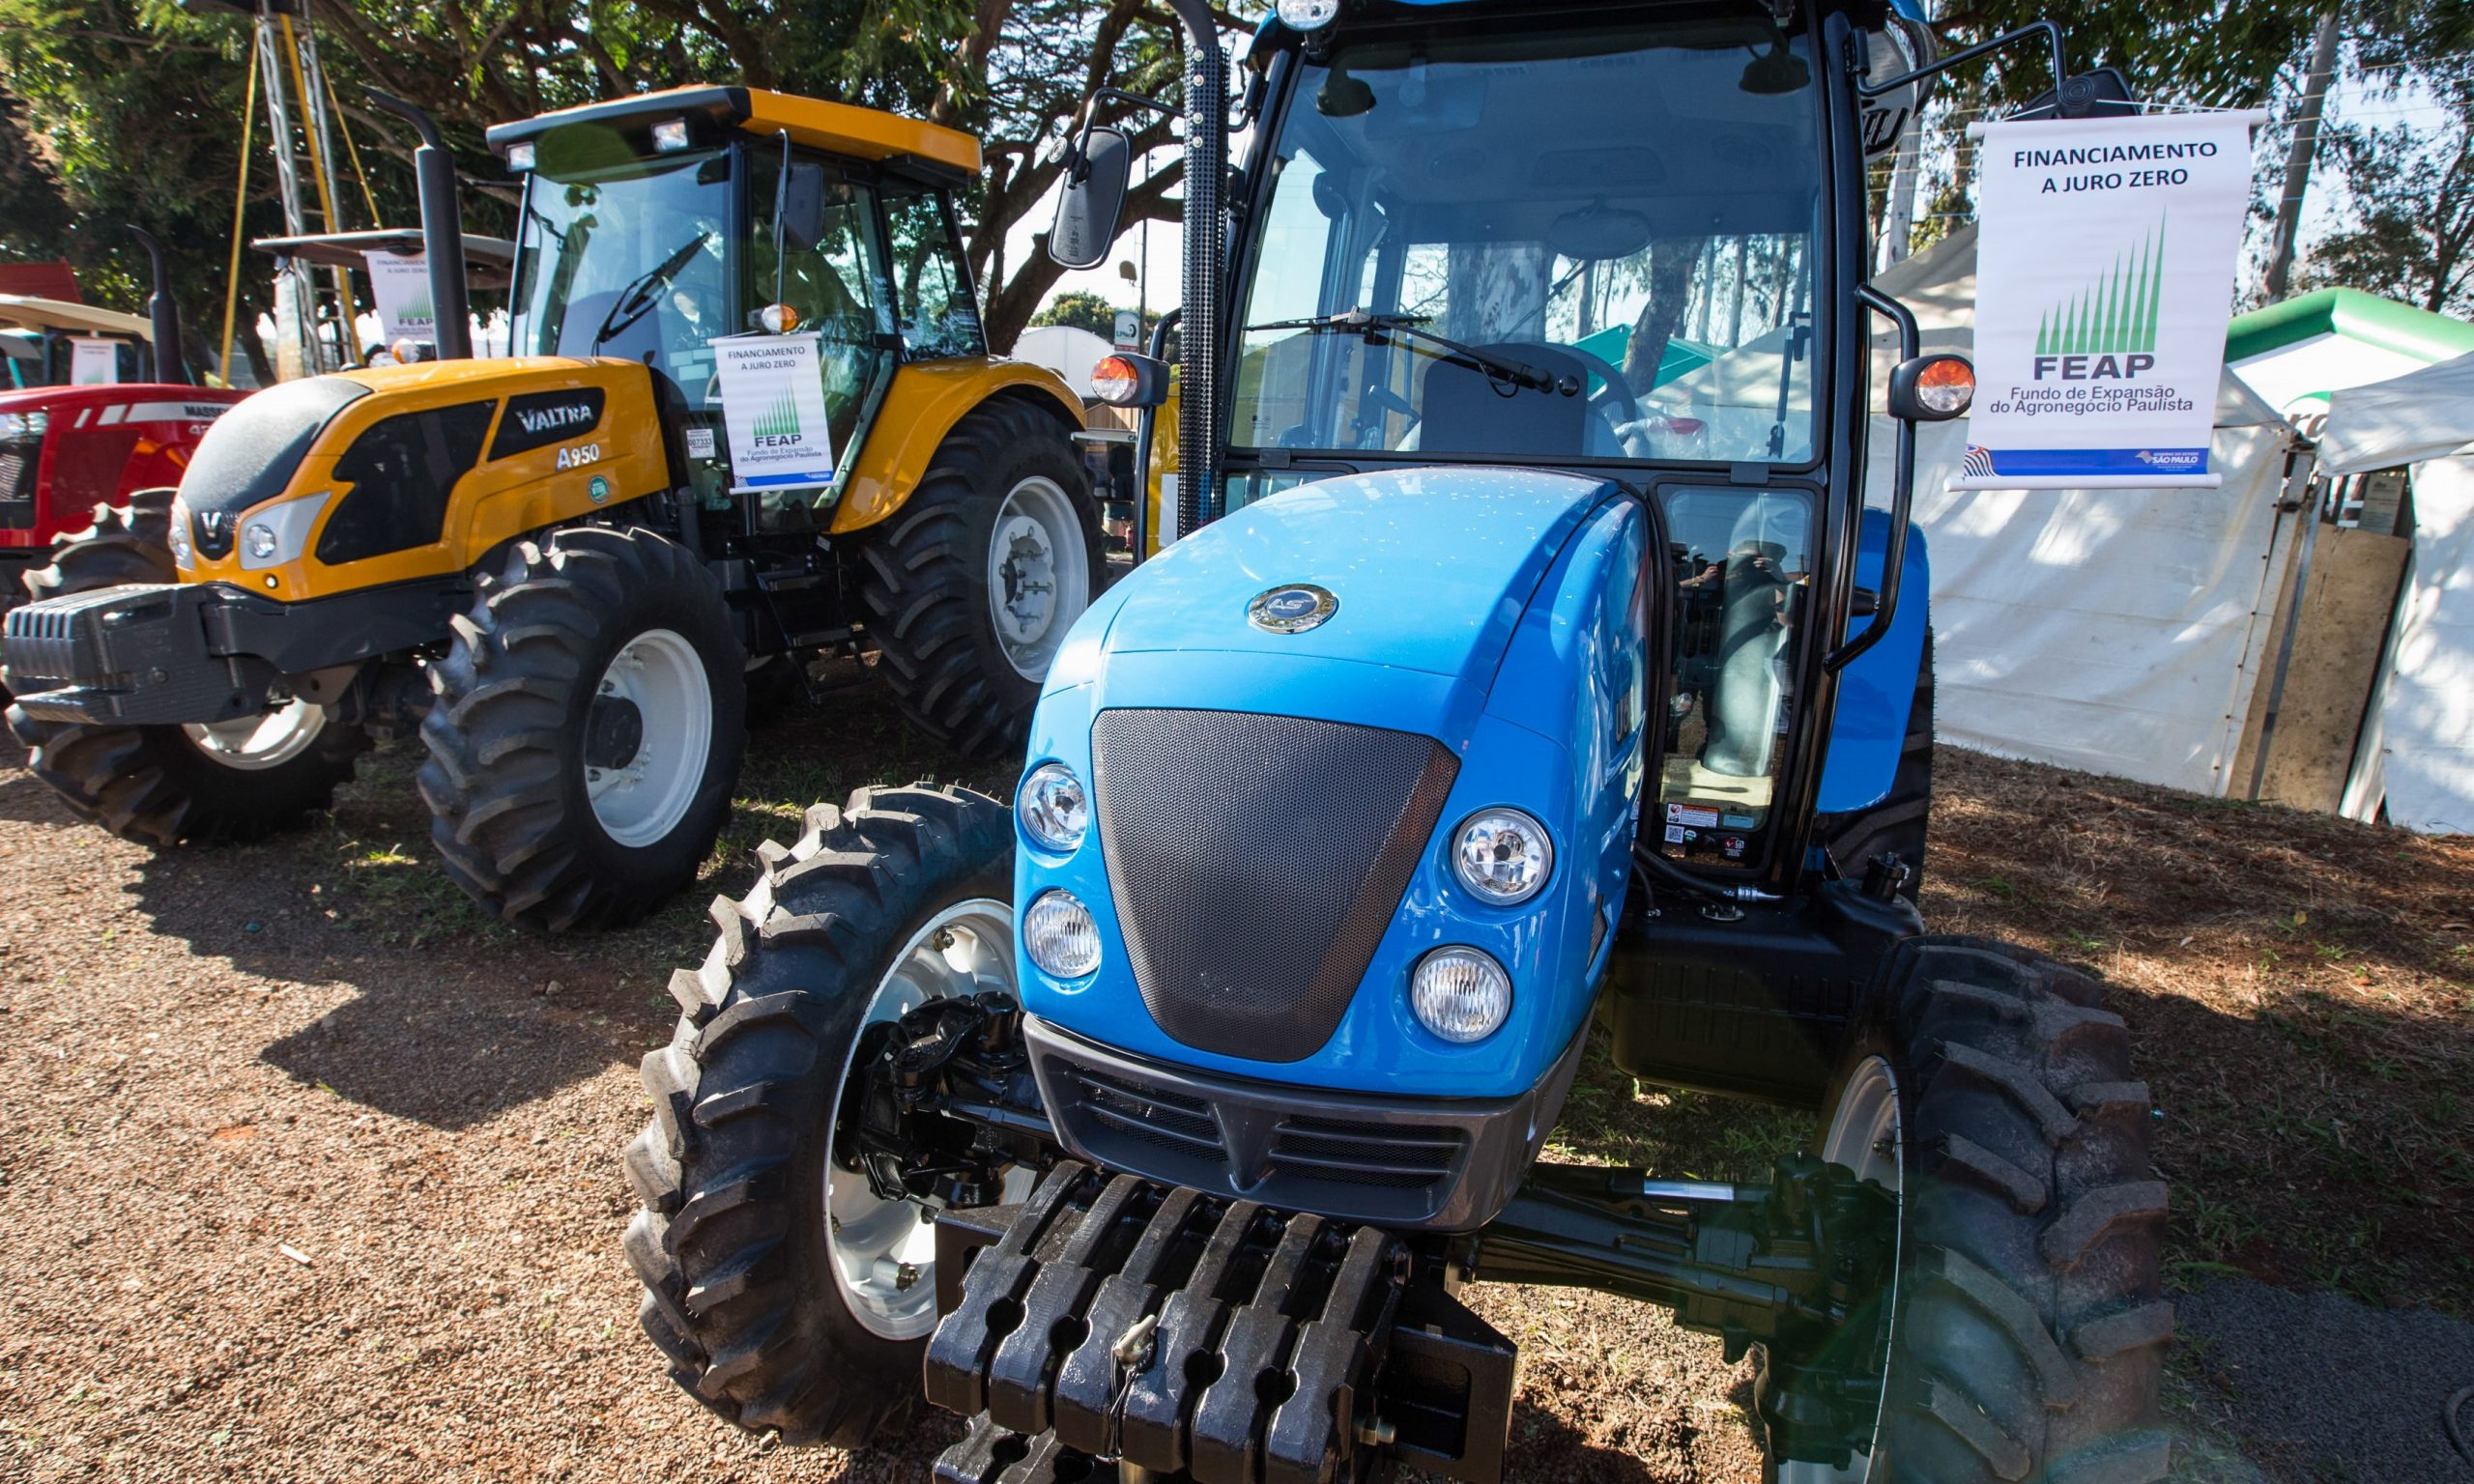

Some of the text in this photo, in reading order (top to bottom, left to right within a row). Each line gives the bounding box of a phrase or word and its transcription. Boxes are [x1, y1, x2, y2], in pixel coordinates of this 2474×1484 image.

[2013, 141, 2219, 169] FINANCIAMENTO
[2041, 168, 2189, 194] A JURO ZERO
[728, 346, 806, 360] FINANCIAMENTO
[750, 361, 771, 370] JURO
[773, 359, 796, 369] ZERO
[2033, 354, 2156, 382] FEAP
[2010, 385, 2175, 402] Fundo de Expansão
[1990, 397, 2194, 416] do Agronegócio Paulista
[515, 403, 593, 433] VALTRA
[754, 434, 802, 447] FEAP
[557, 443, 600, 472] A950
[780, 445, 814, 455] Expansão
[794, 450, 822, 459] Paulista
